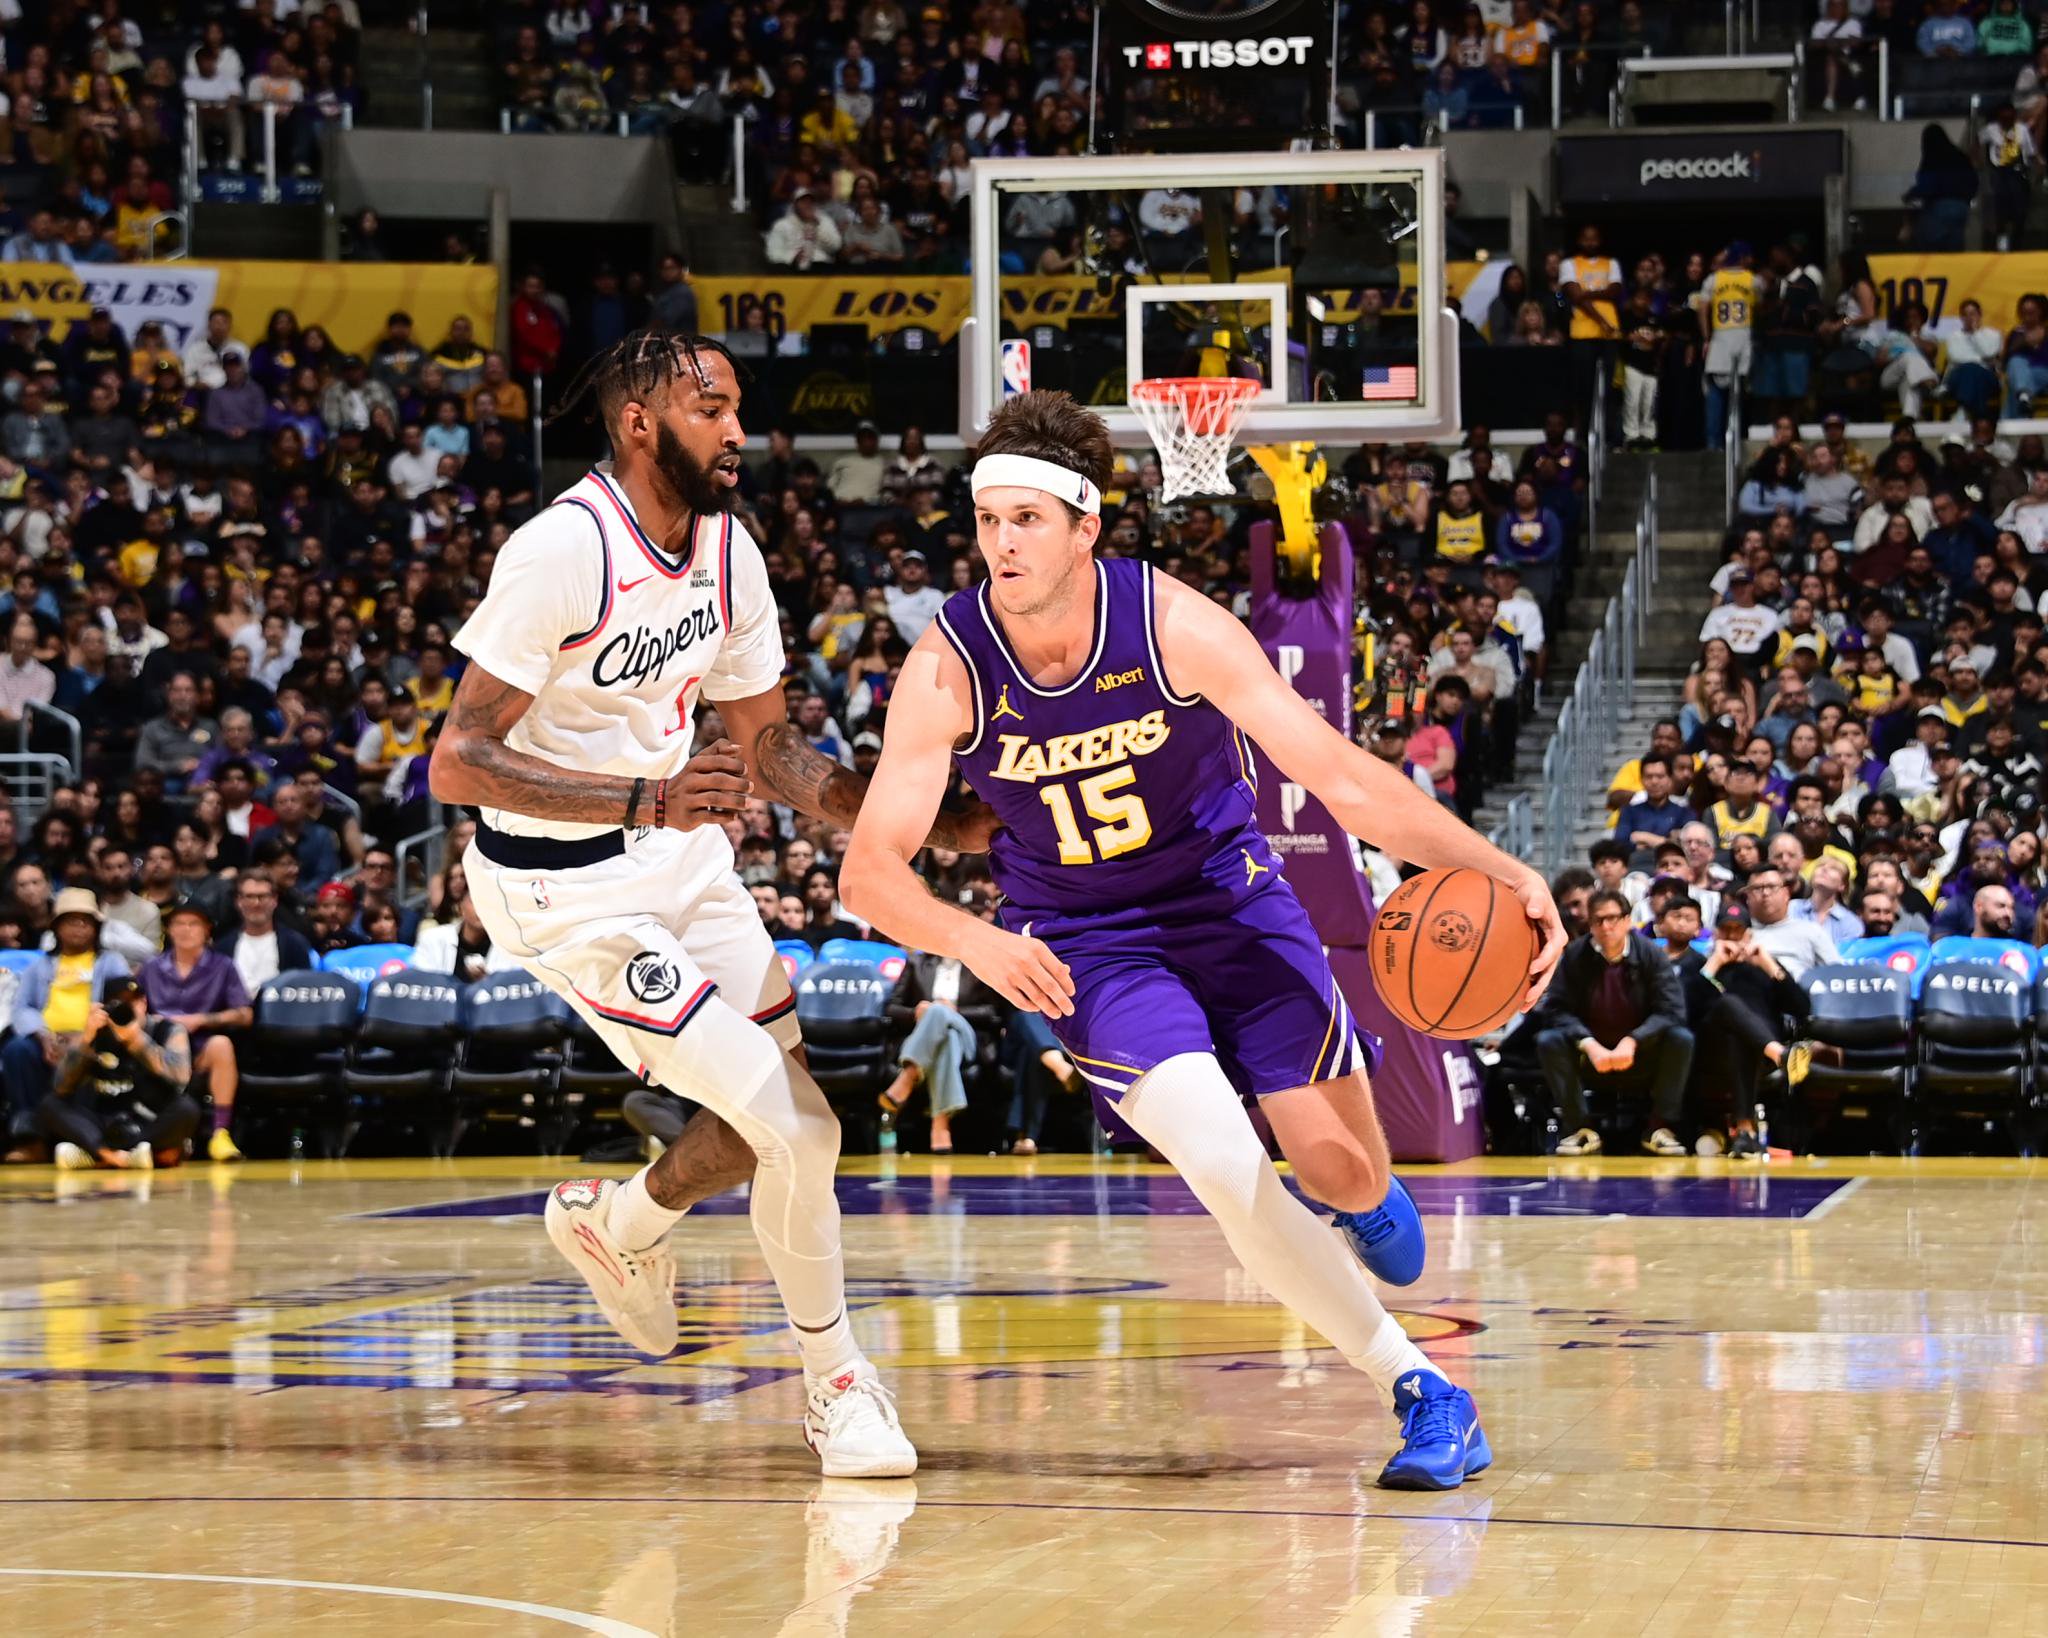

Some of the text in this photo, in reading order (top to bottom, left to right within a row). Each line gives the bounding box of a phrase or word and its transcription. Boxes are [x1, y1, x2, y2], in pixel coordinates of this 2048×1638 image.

[1173, 36, 1314, 69] TISSOT
[1640, 150, 1751, 186] peacock
[833, 291, 941, 317] LOS
[692, 569, 708, 579] VISIT
[592, 598, 720, 688] Clippers
[1095, 666, 1145, 693] Albert
[988, 709, 1171, 783] LAKERS
[1039, 764, 1153, 865] 15
[281, 986, 346, 1003] DELTA
[392, 982, 457, 1004] DELTA
[818, 978, 884, 995] DELTA
[1829, 977, 1898, 994] DELTA
[1950, 974, 2019, 997] DELTA
